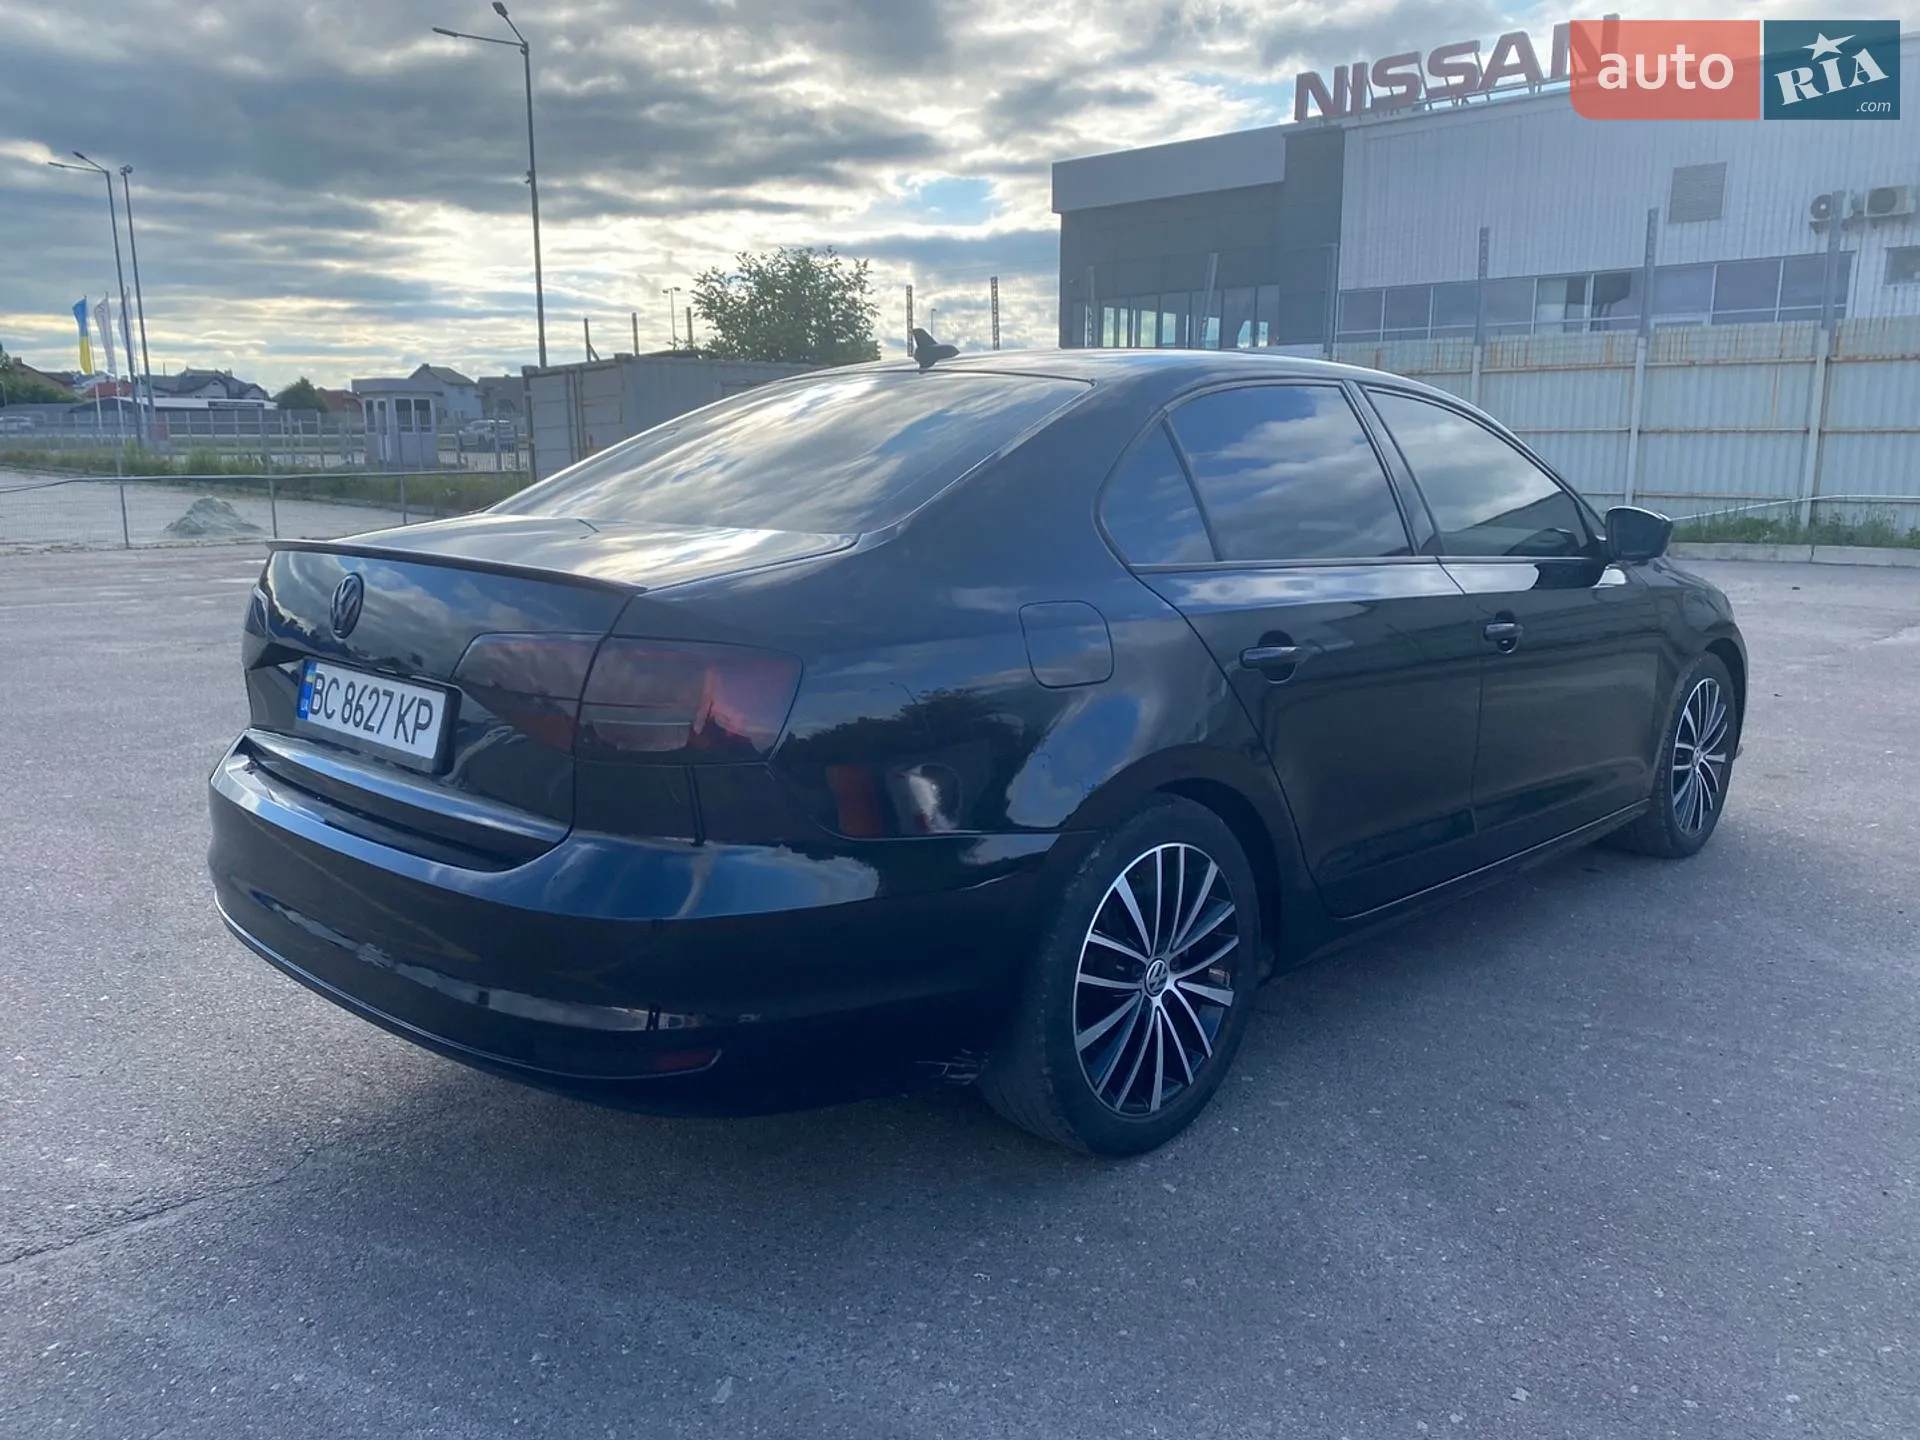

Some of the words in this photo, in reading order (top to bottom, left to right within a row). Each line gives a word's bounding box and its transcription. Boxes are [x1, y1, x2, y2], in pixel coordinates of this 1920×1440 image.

[1294, 13, 1620, 121] NISSAN
[310, 672, 340, 720] BC
[341, 681, 394, 734] 8627
[393, 693, 433, 745] KP
